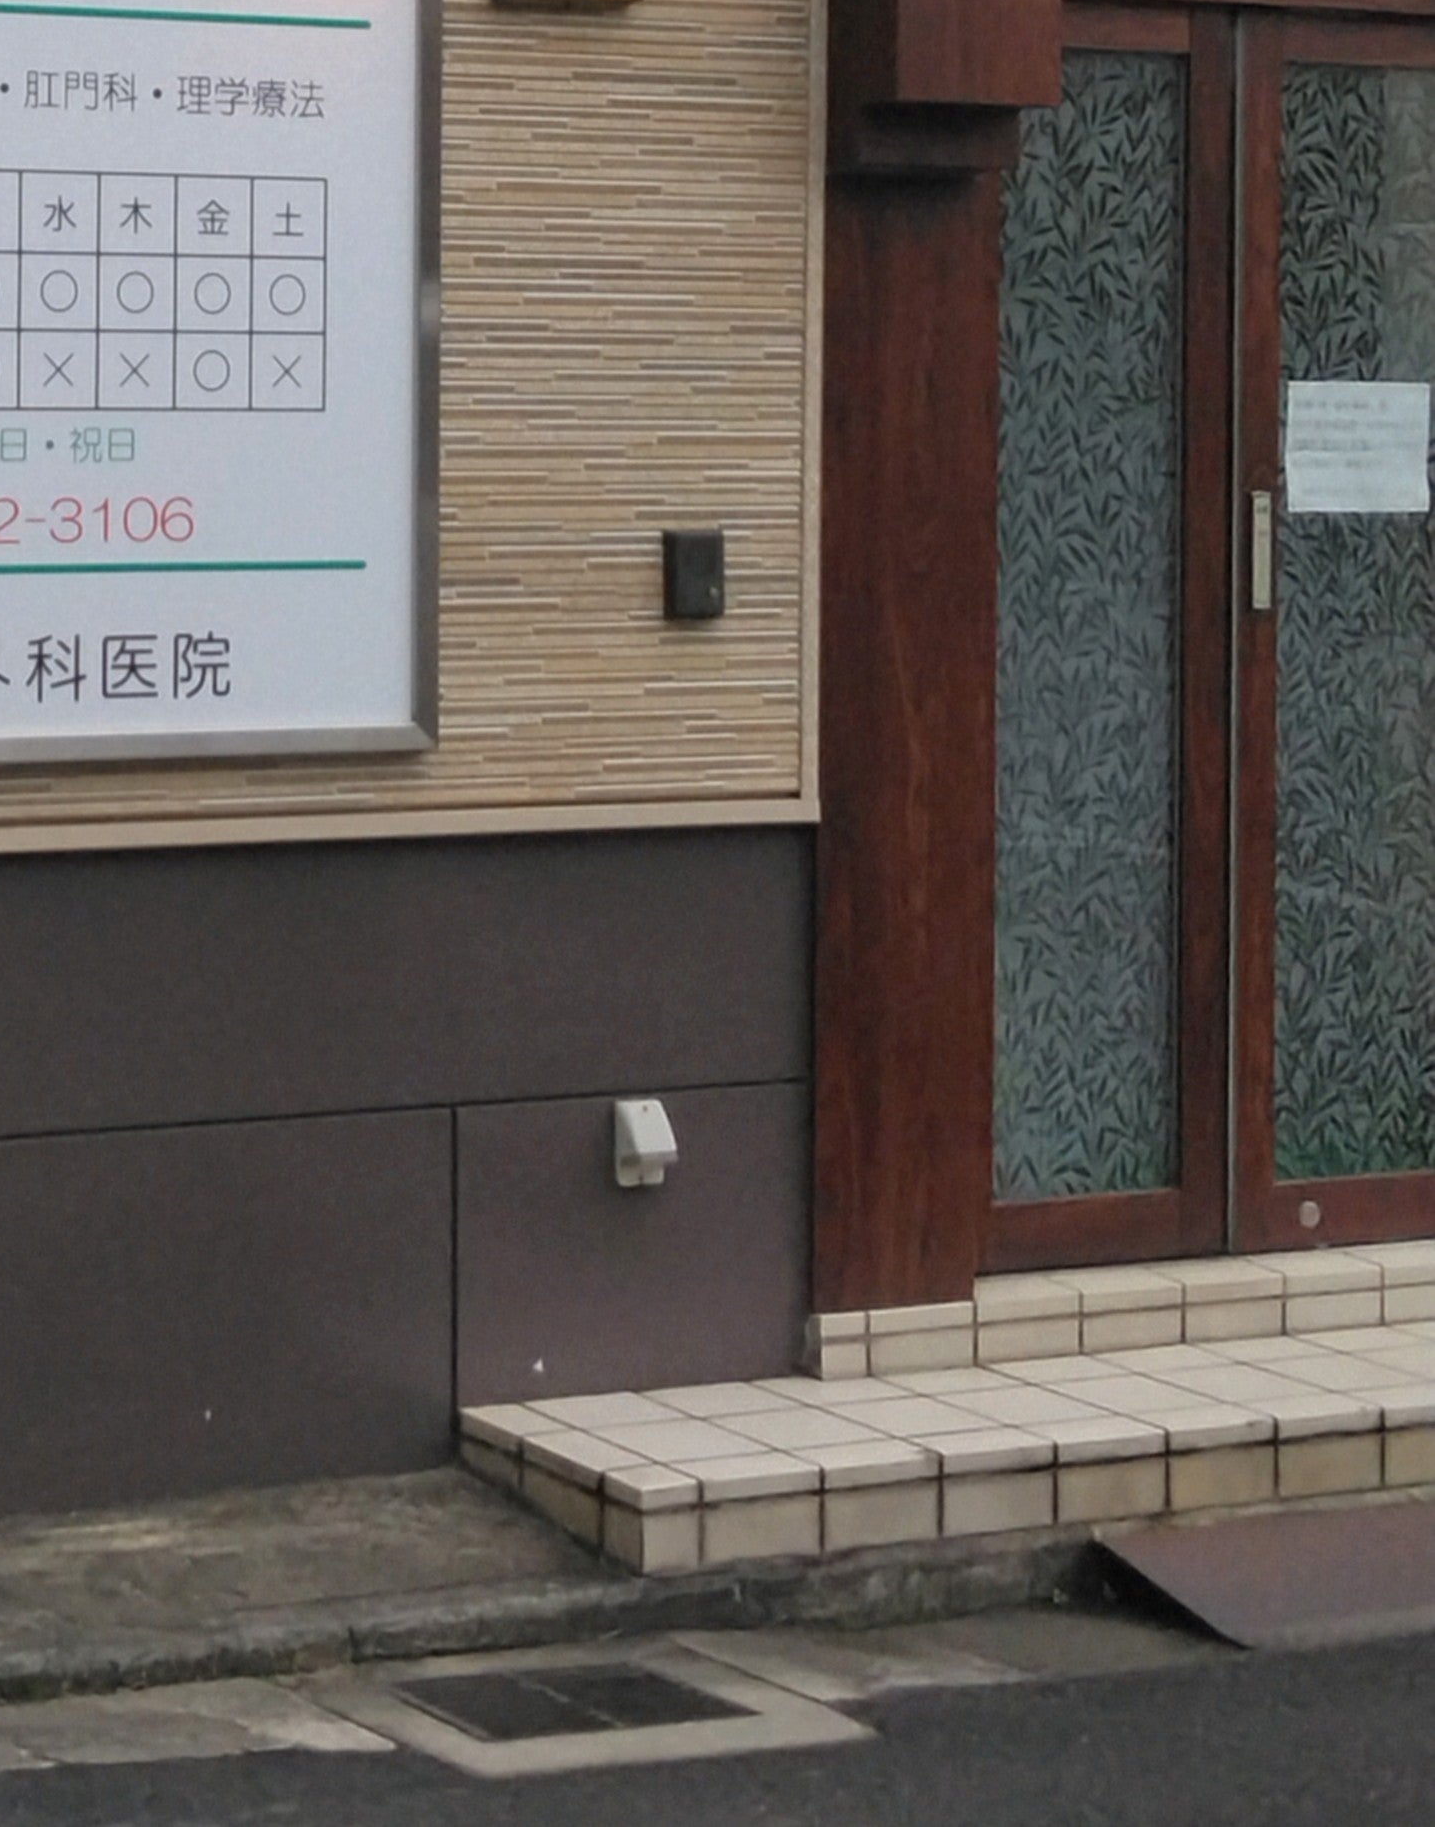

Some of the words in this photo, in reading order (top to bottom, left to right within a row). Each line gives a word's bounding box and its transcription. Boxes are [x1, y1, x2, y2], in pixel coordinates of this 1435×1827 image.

[42, 194, 78, 233] 水
[118, 196, 153, 235] 木
[196, 198, 231, 236] 金
[272, 201, 305, 237] 土
